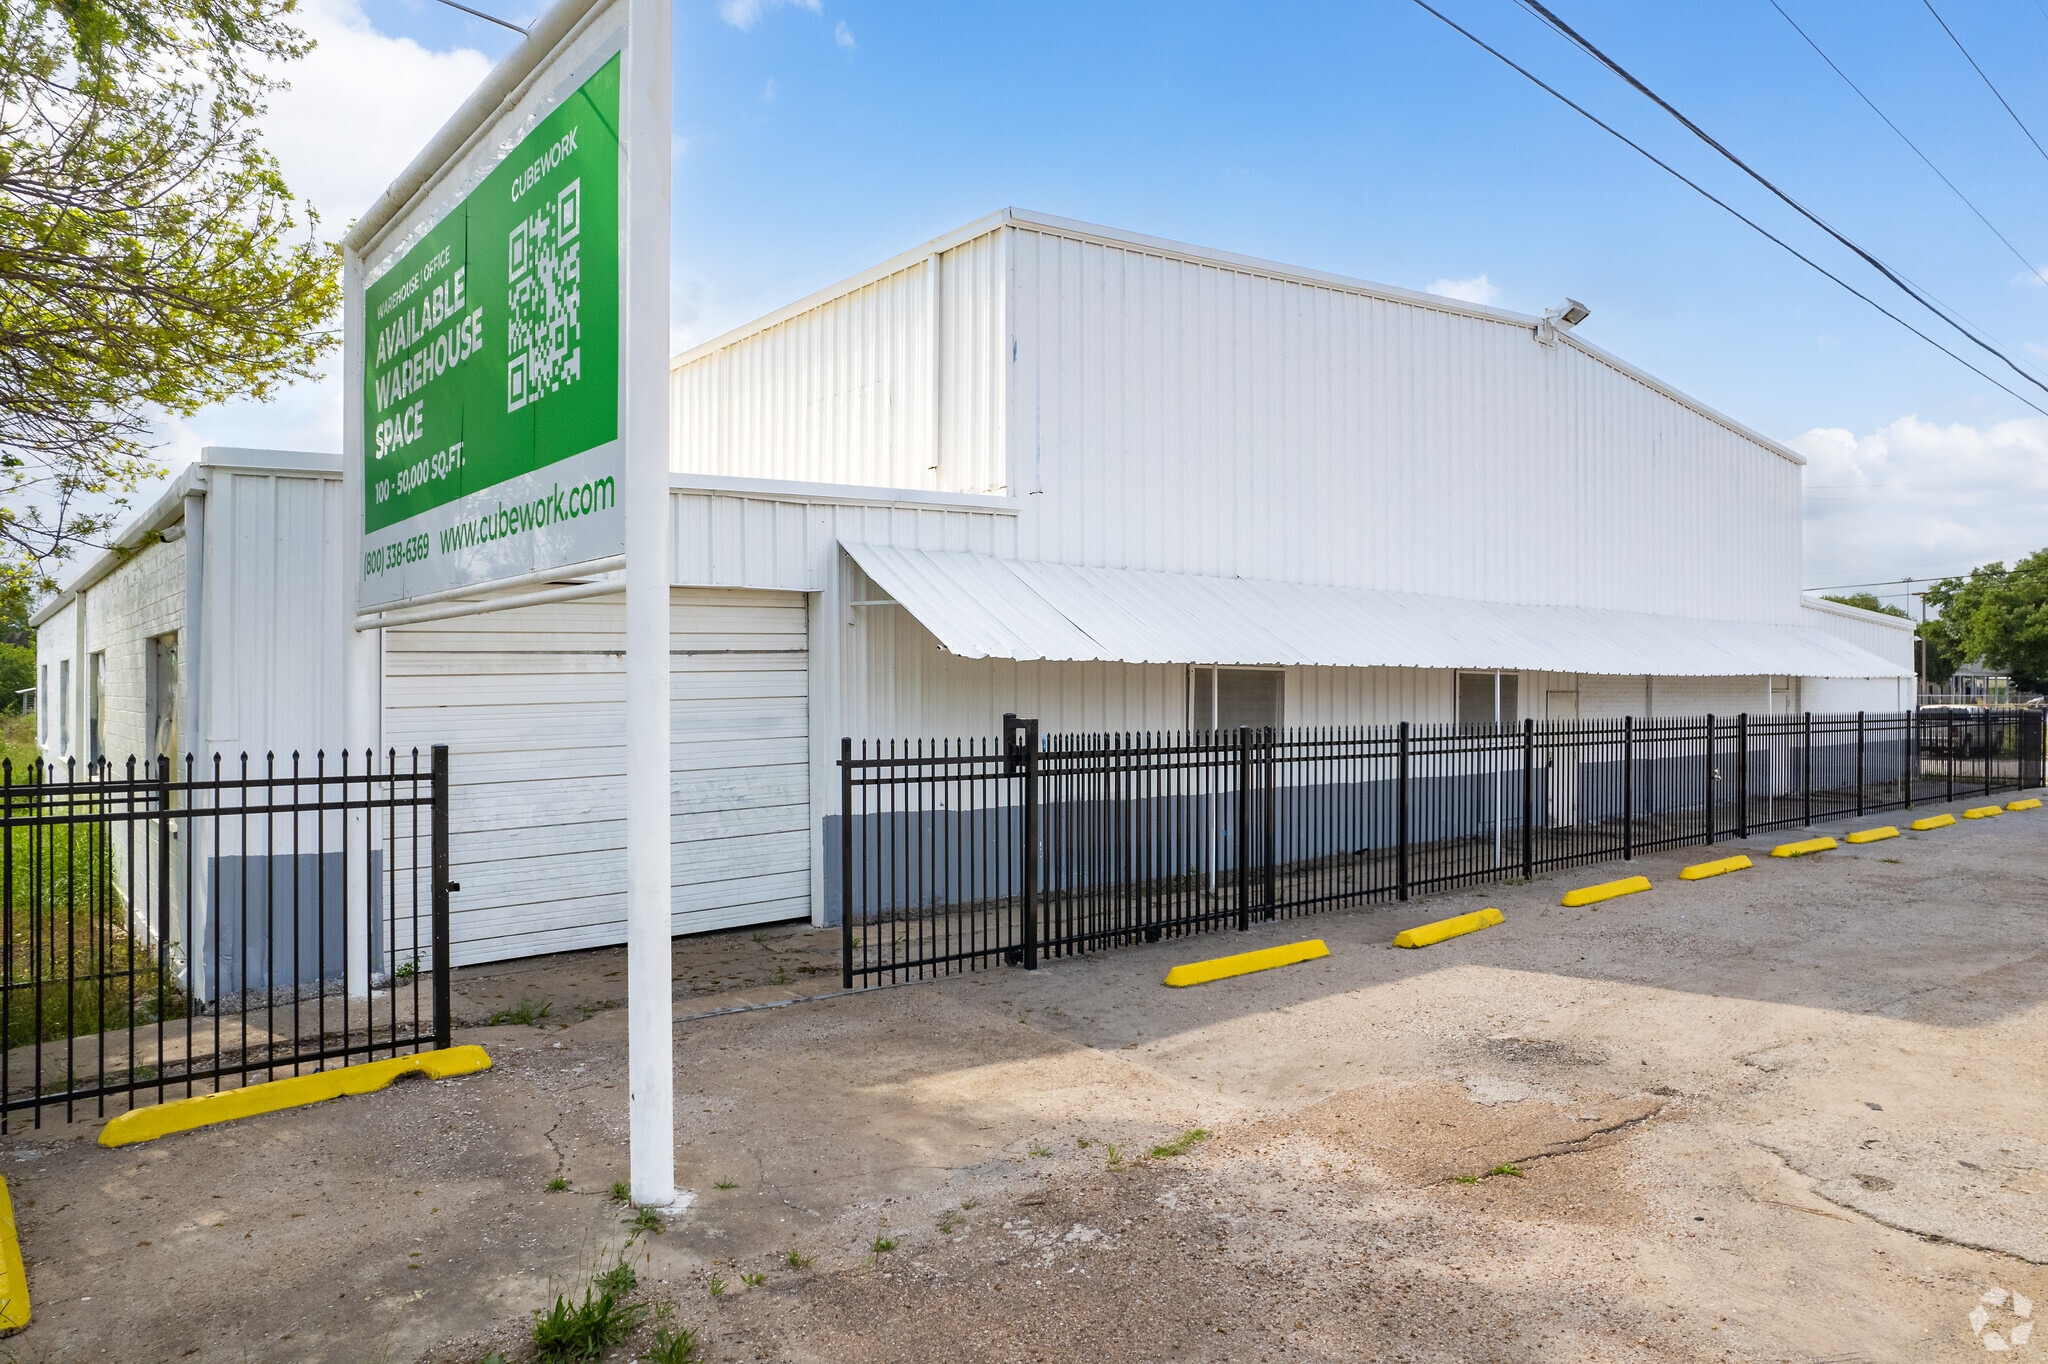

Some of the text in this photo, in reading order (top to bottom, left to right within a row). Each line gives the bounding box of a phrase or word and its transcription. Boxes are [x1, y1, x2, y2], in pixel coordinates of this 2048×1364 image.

[511, 125, 578, 203] CUBEWORK
[375, 265, 466, 369] AVAILABLE
[377, 272, 419, 320] WAREHOUSE
[423, 245, 450, 282] OFFICE
[375, 306, 483, 413] WAREHOUSE
[375, 399, 424, 460] SPACE
[375, 478, 390, 504] 100
[397, 458, 429, 495] 50,000
[431, 441, 466, 480] SQ.FT.
[363, 475, 615, 582] (800) 338-6369 www.cubework.com
